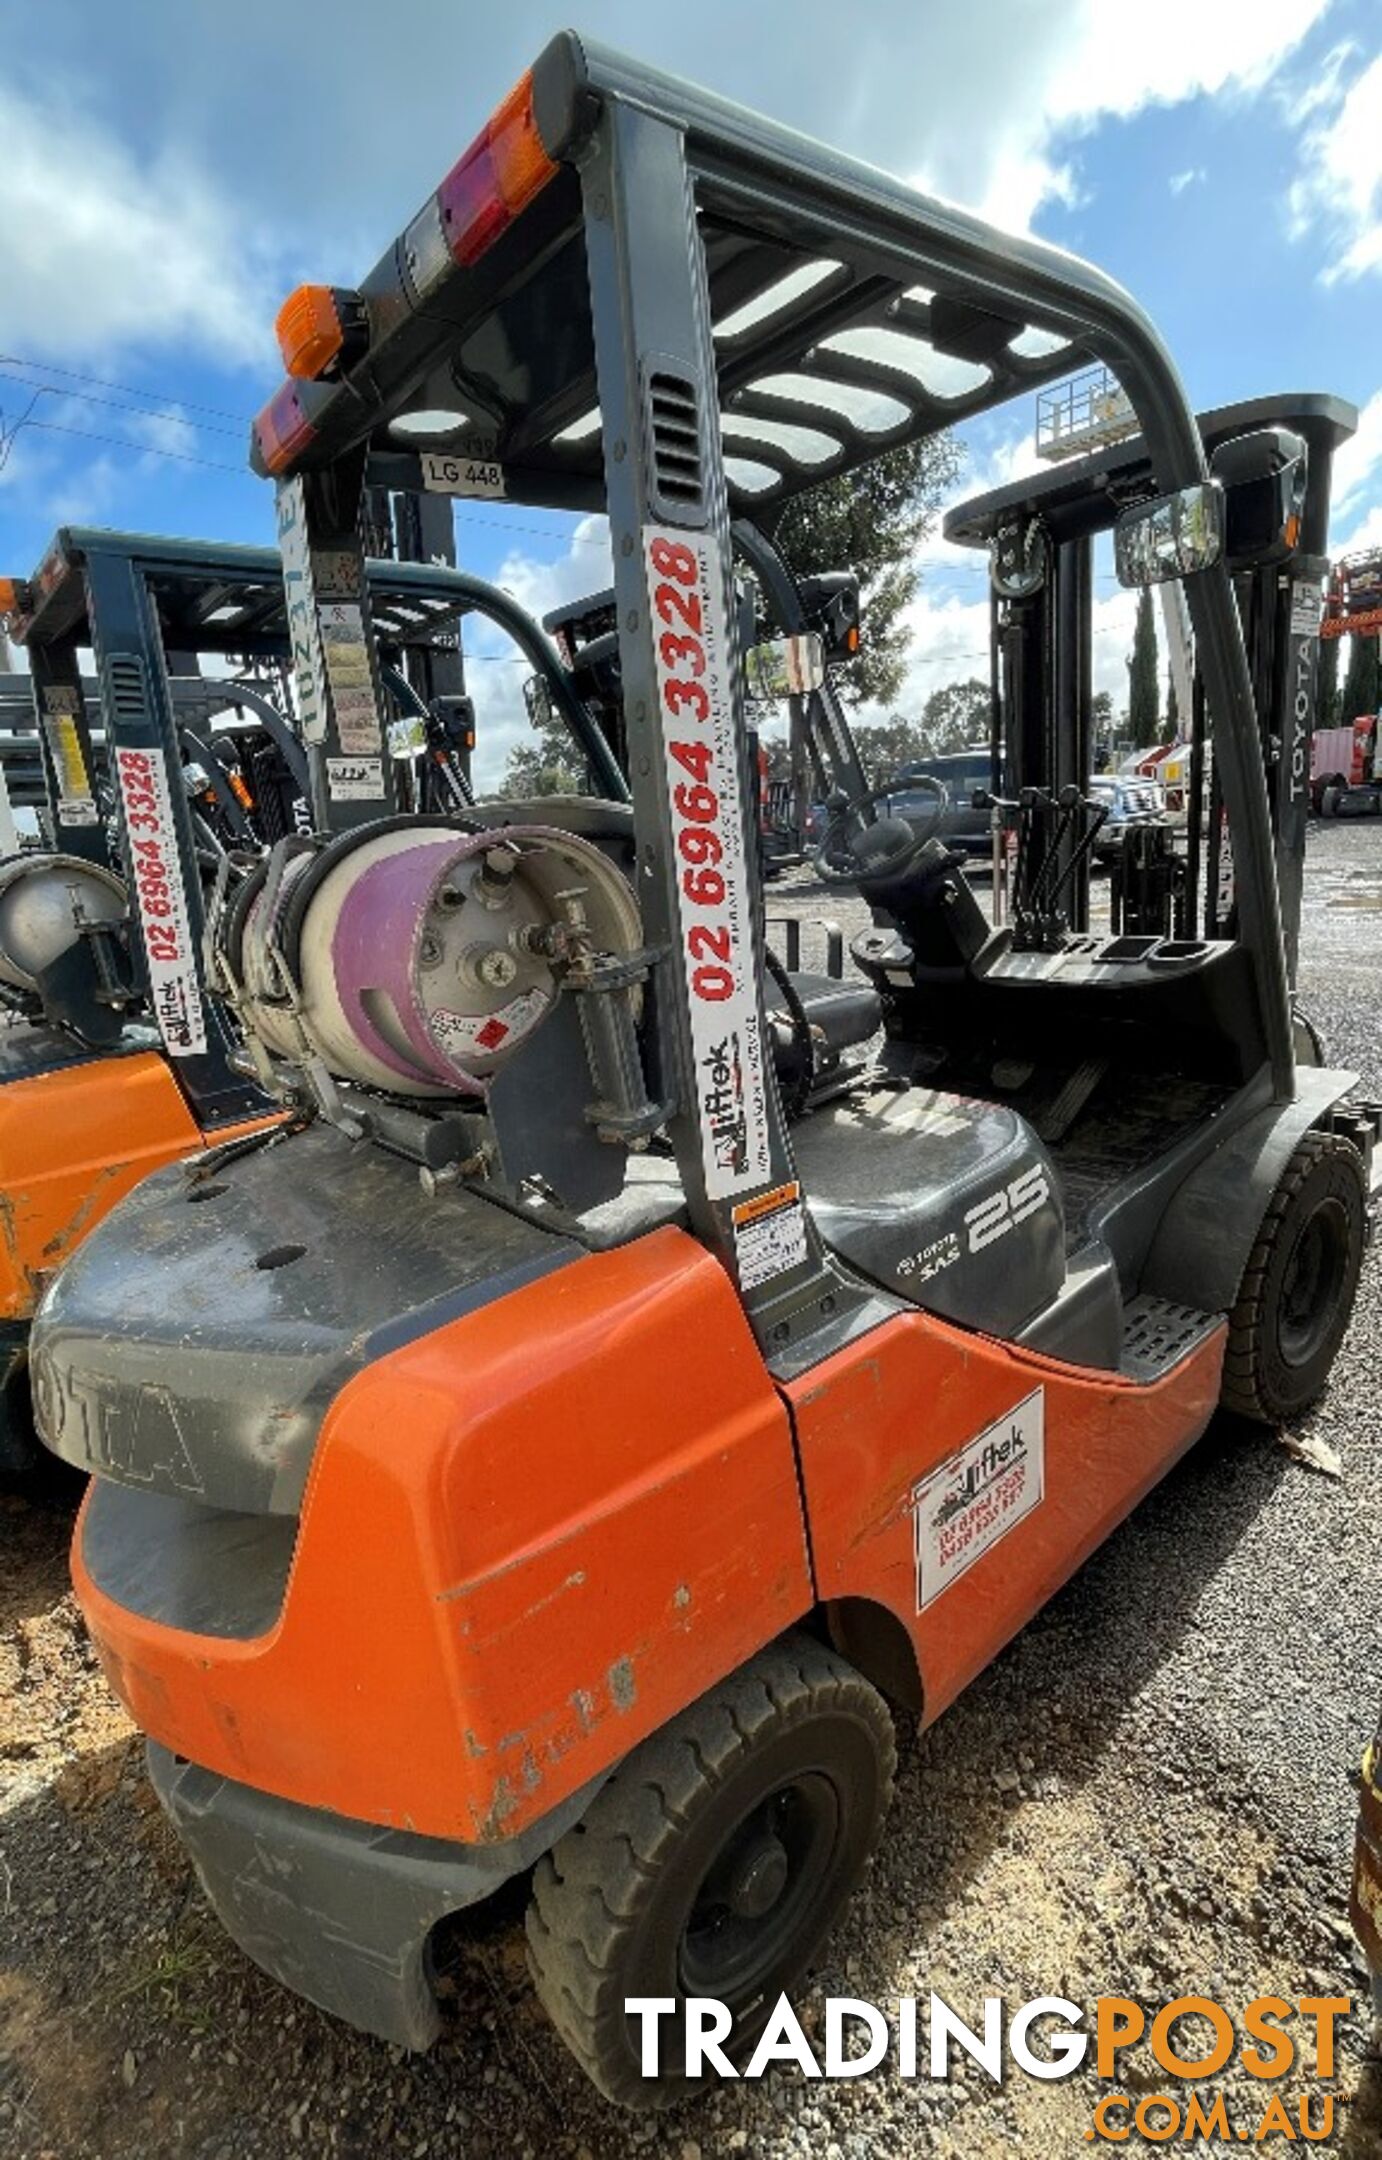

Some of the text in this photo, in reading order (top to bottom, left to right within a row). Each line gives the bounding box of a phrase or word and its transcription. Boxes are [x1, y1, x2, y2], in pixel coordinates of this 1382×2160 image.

[429, 460, 500, 486] LG 448
[1289, 638, 1312, 803] TOYOTA
[119, 751, 160, 834] 3328
[650, 537, 736, 1002] 02 6964 3328
[134, 838, 172, 918] 6964
[147, 923, 179, 963] 02
[964, 1162, 1050, 1254] 25
[919, 1245, 961, 1283] SAS
